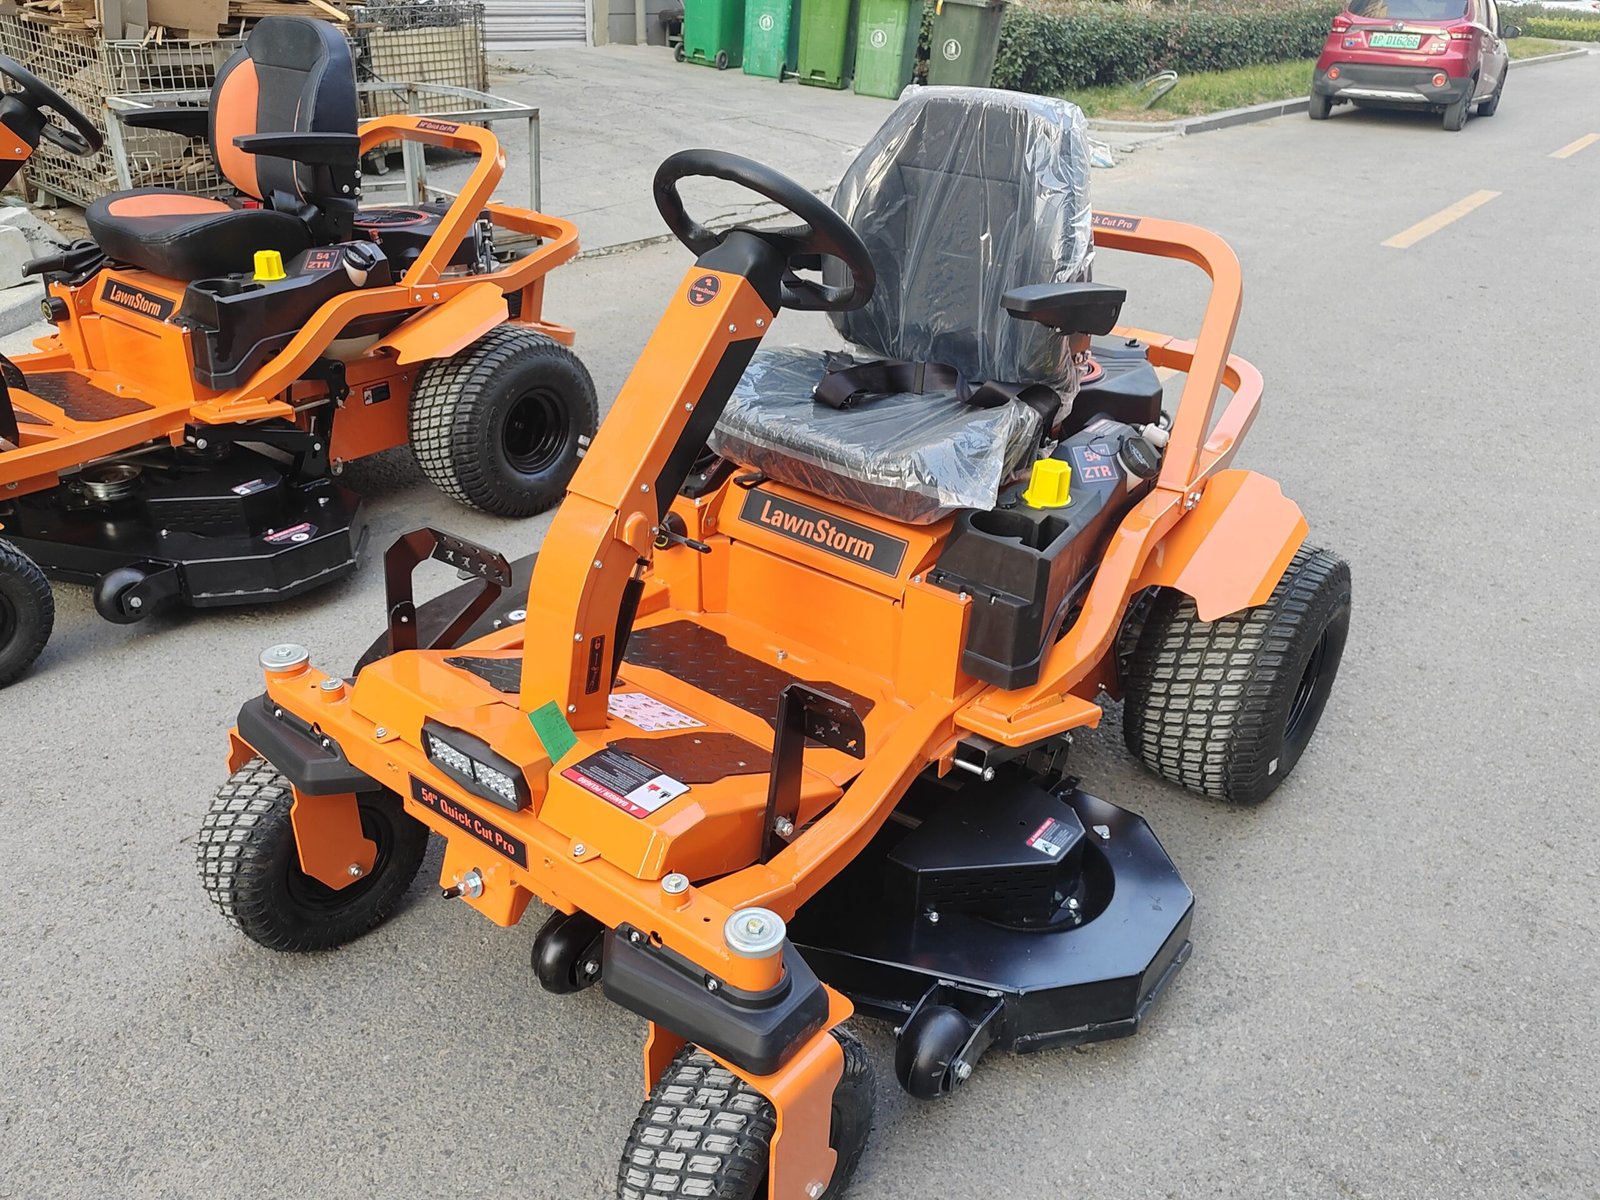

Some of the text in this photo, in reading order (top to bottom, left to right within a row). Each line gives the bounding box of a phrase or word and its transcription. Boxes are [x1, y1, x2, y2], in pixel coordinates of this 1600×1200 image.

[1101, 217, 1117, 226] Cut
[1117, 219, 1133, 229] Pro
[316, 252, 335, 260] 54"
[307, 261, 331, 269] ZTR
[109, 284, 162, 317] LawnStorm
[1082, 465, 1112, 479] ZTR
[760, 499, 875, 561] LawnStorm
[577, 776, 602, 792] PELIGRO
[605, 790, 629, 807] DANGER
[421, 787, 515, 855] 54" Quick Cut Pro
